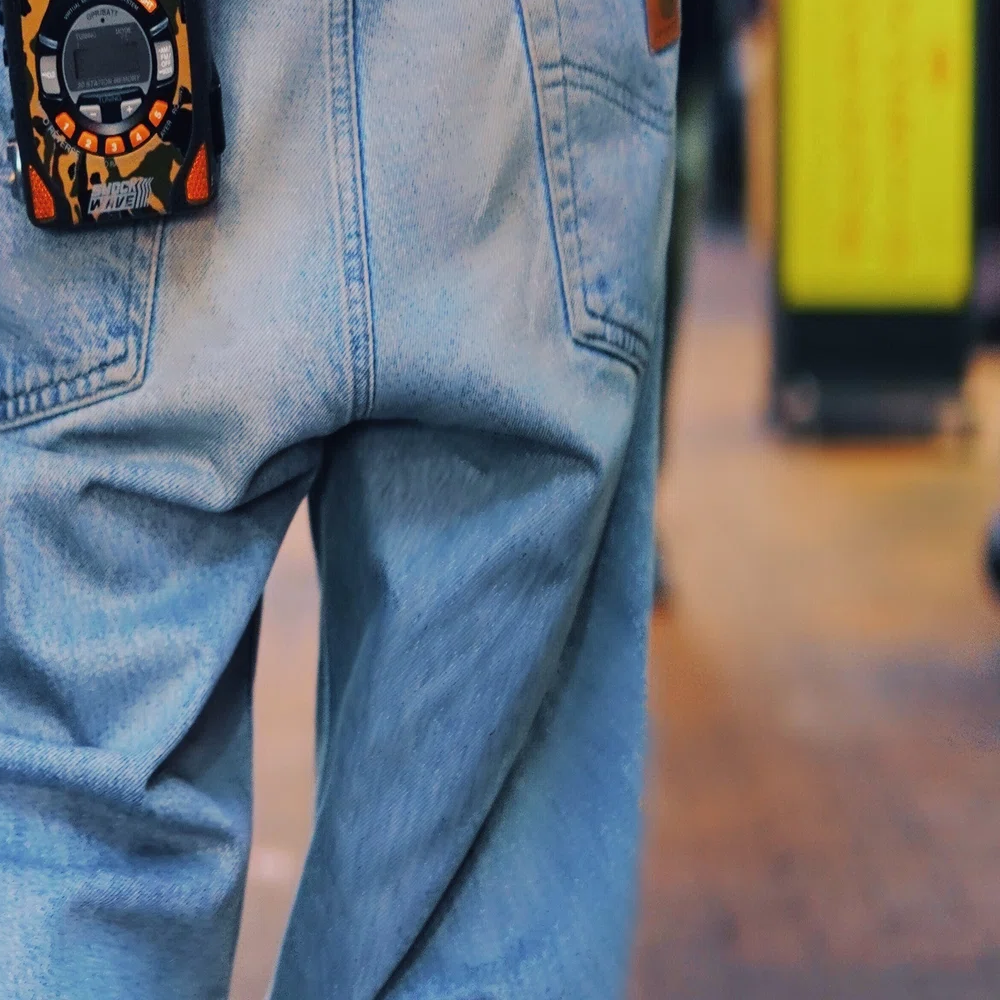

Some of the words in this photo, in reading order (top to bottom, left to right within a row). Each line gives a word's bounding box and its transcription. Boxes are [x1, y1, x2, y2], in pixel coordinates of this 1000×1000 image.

[63, 122, 70, 131] 1
[135, 131, 143, 142] 4
[85, 138, 92, 149] 2
[111, 141, 118, 153] 3
[87, 192, 137, 214] WAVE
